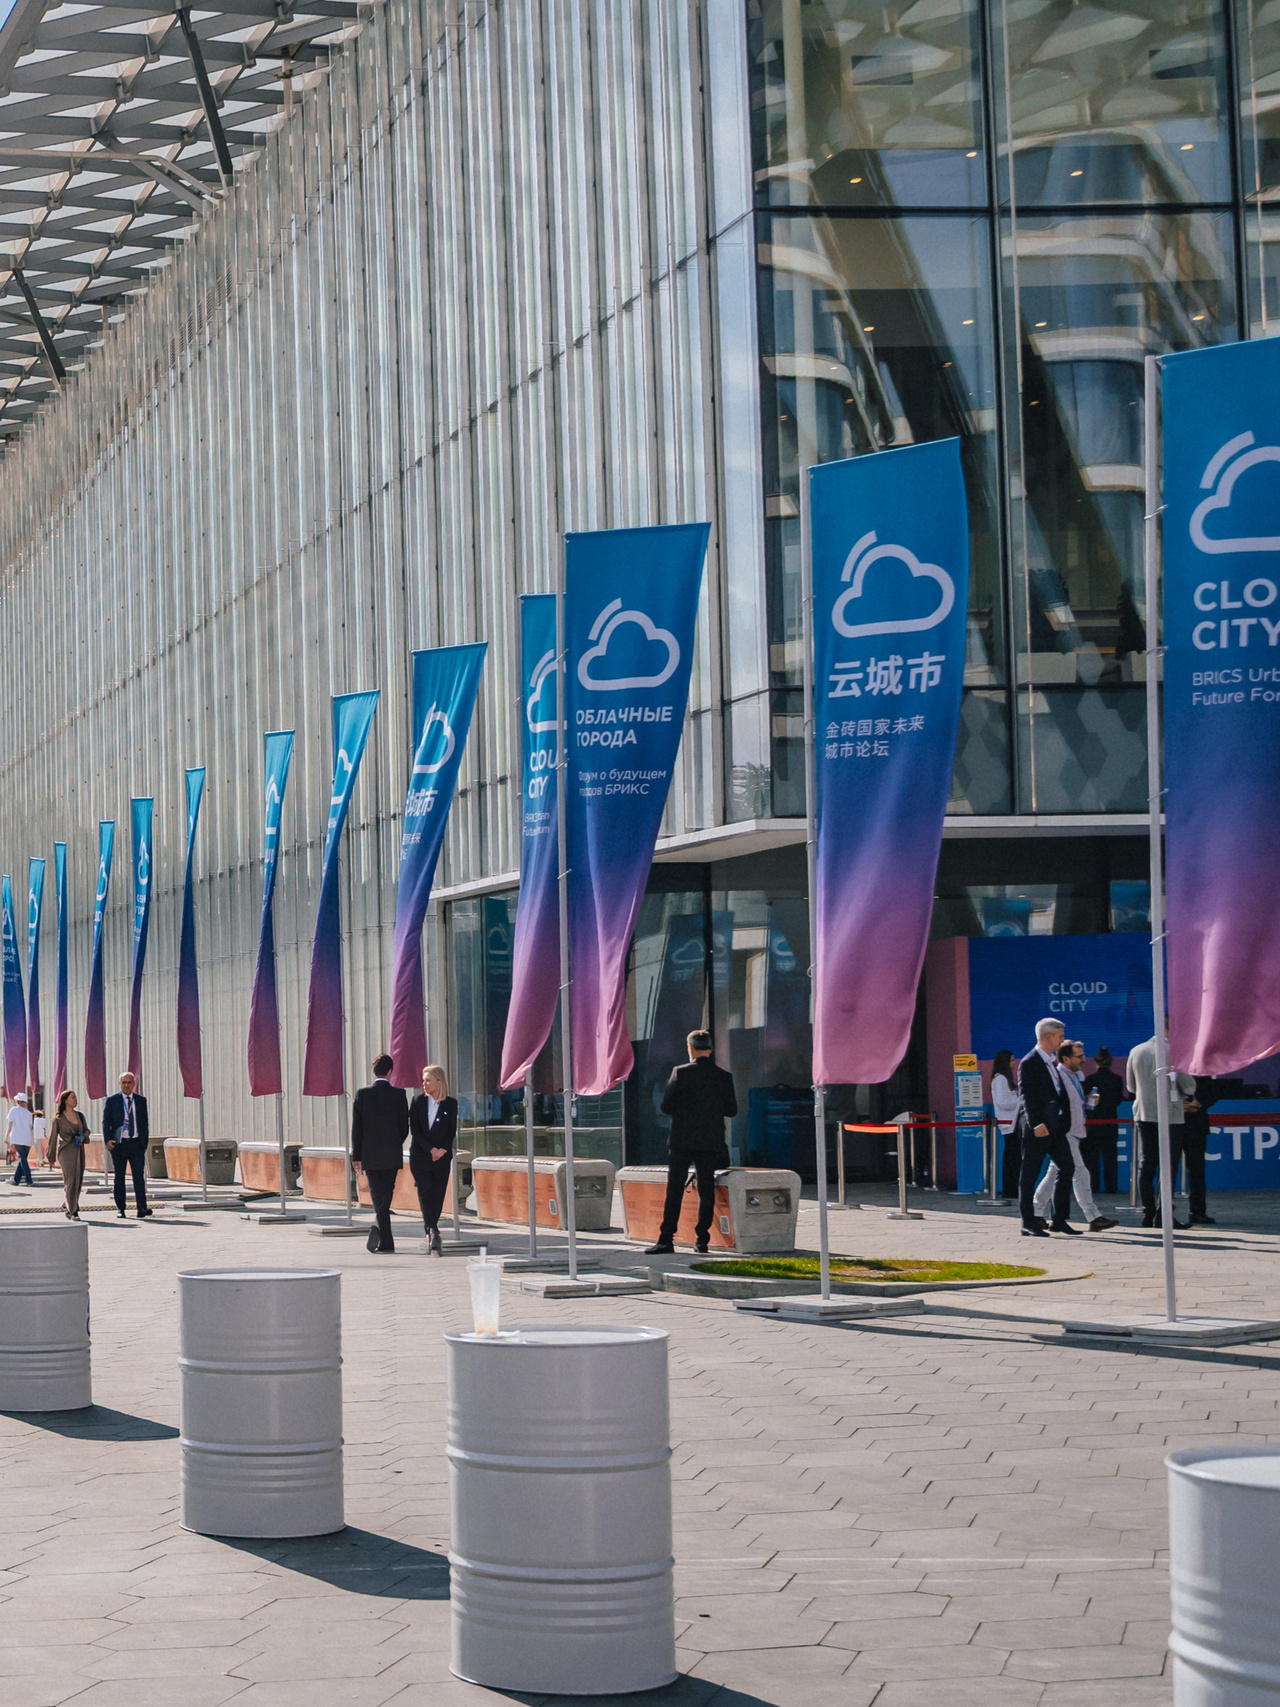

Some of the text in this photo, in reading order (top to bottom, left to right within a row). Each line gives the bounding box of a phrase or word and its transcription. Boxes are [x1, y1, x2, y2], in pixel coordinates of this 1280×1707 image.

[1191, 617, 1280, 651] CITY
[827, 651, 946, 699] 云城市
[1192, 668, 1243, 687] BRICS
[1192, 690, 1245, 706] Future
[575, 706, 673, 725] ОБЛАЧНЫЕ
[825, 714, 926, 740] 金砖国家未来
[576, 729, 637, 749] ГОРОДА
[824, 740, 889, 760] 城市论坛
[608, 768, 667, 783] будущем
[604, 783, 650, 795] БРИКС
[405, 787, 438, 817] 城市
[1048, 981, 1108, 995] CLOUD
[1048, 998, 1089, 1012] CITY
